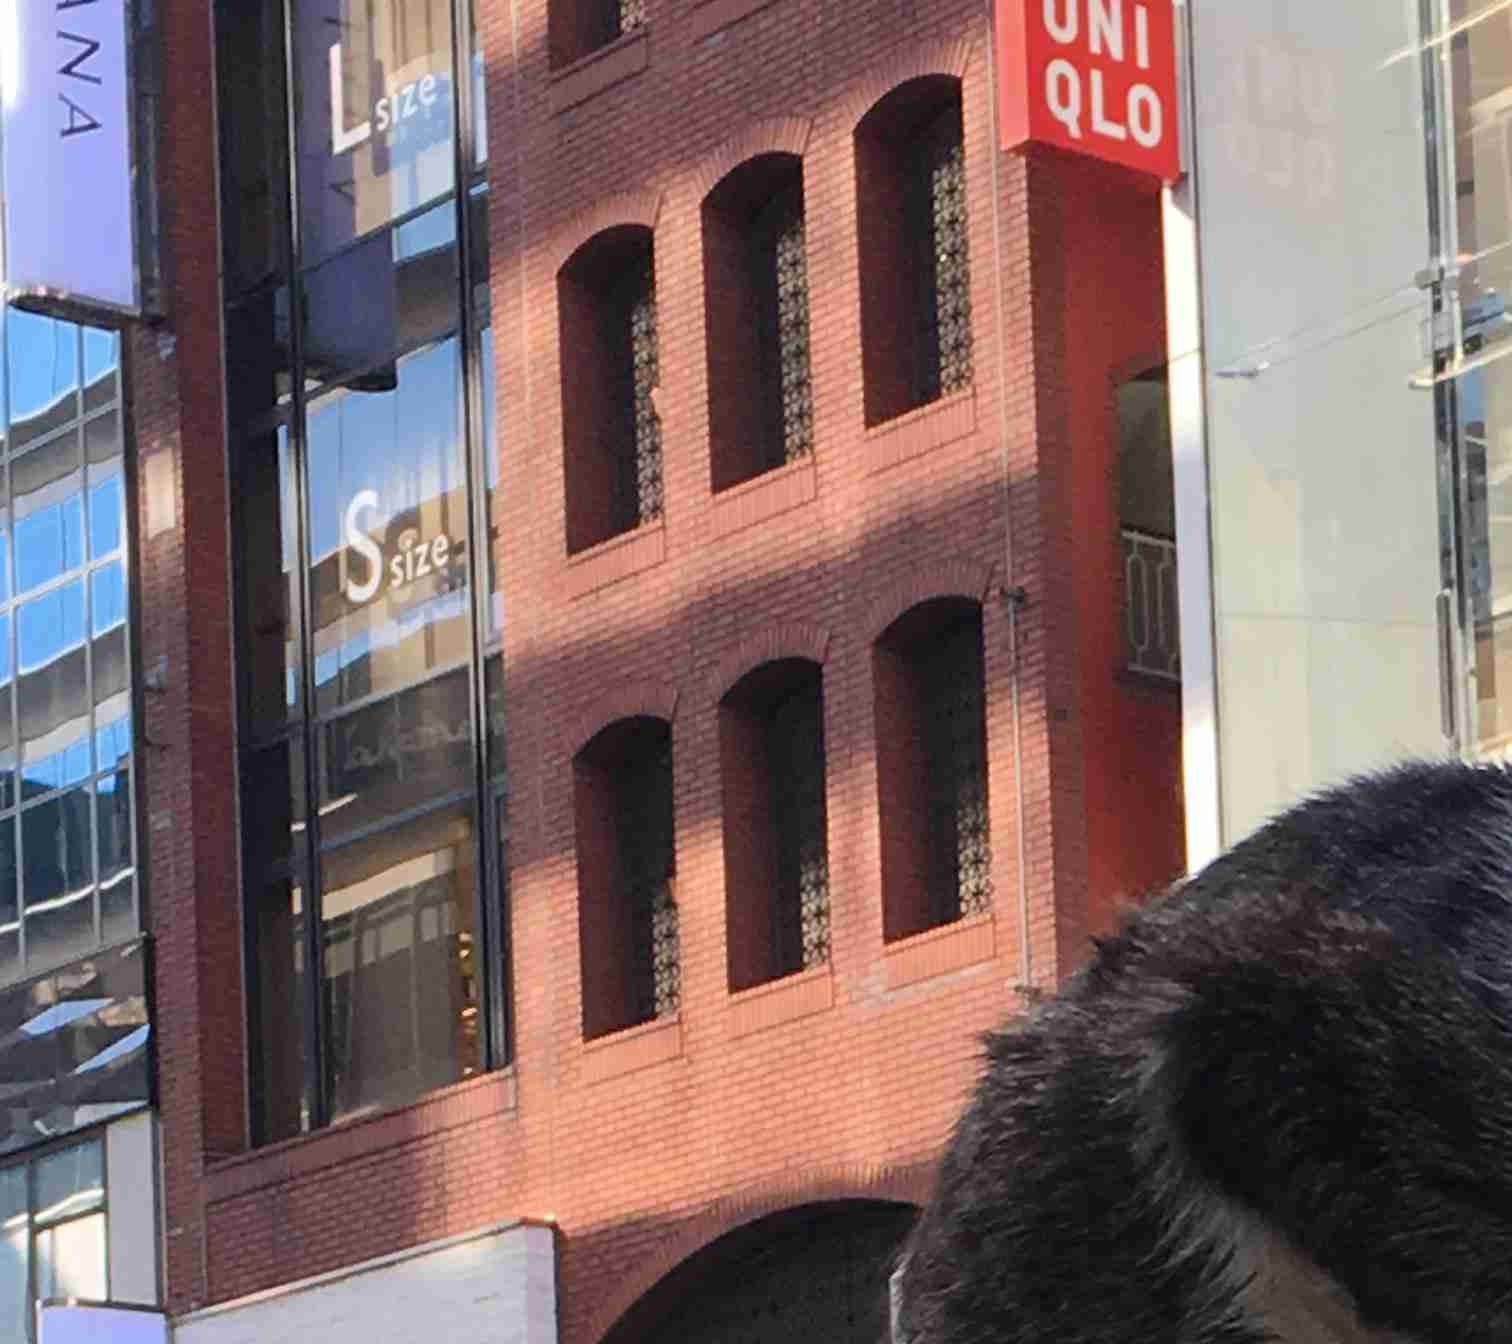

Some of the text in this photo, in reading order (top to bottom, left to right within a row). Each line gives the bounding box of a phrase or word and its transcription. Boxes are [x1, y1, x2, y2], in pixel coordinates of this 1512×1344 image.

[55, 0, 103, 137] NA
[1041, 0, 1151, 69] UNI
[329, 43, 438, 156] L size
[1045, 58, 1162, 148] QLO
[345, 489, 449, 602] S size
